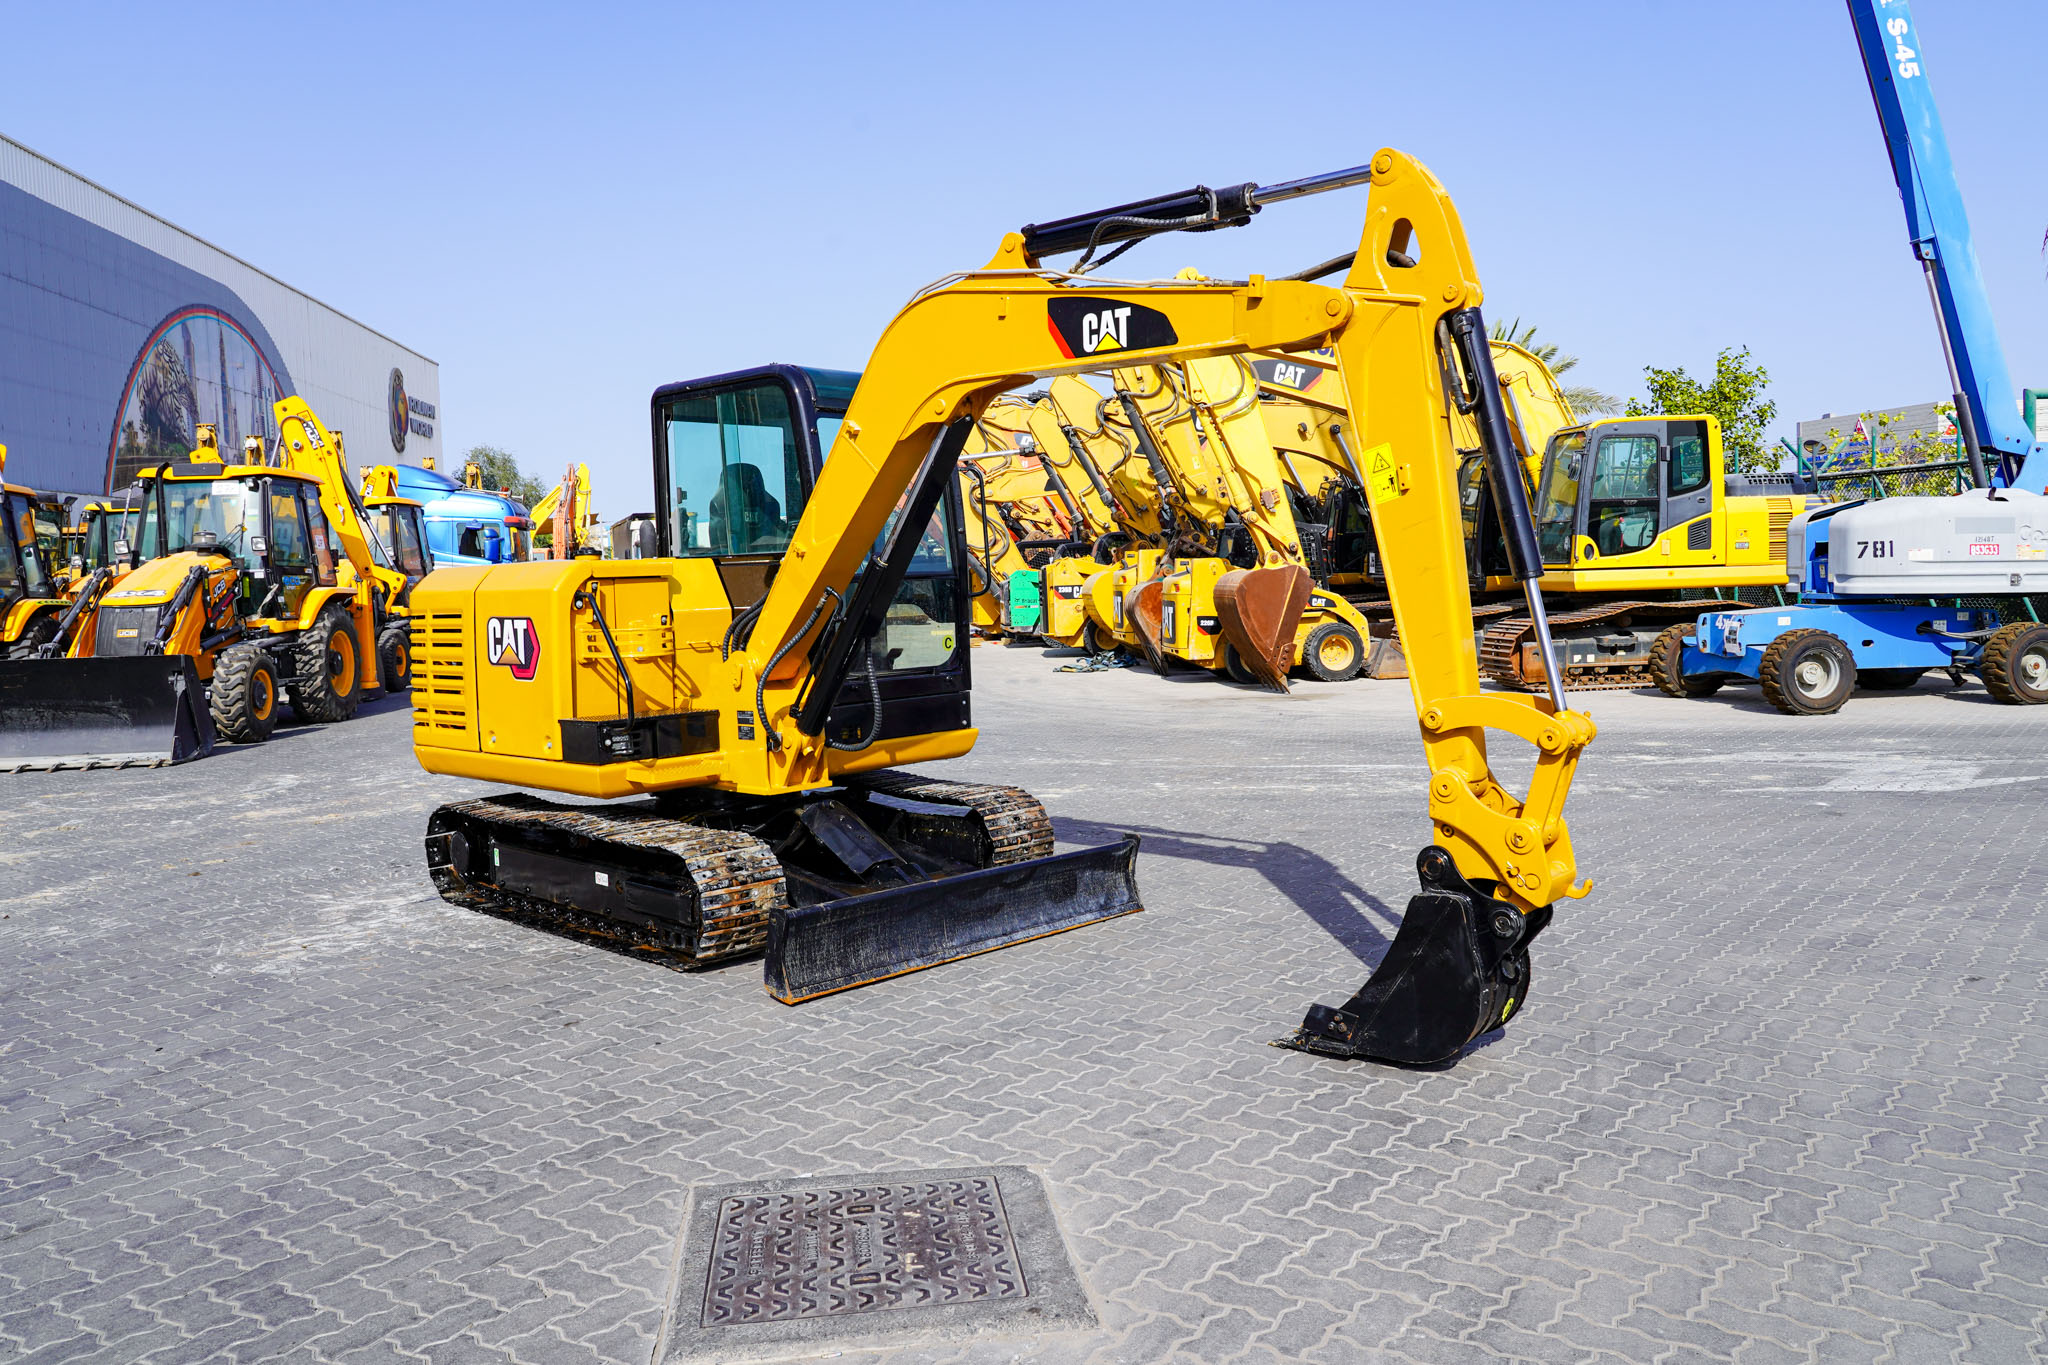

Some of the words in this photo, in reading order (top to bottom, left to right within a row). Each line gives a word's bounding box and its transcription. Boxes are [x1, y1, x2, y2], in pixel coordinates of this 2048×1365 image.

[1886, 17, 1921, 79] S-45
[1082, 306, 1132, 353] CAT
[1273, 362, 1306, 389] CAT
[410, 417, 433, 439] WORLD
[1857, 540, 1894, 559] 781
[213, 579, 226, 598] JCB
[1311, 598, 1327, 607] CAT
[1162, 604, 1174, 638] AT
[488, 617, 528, 665] CAT
